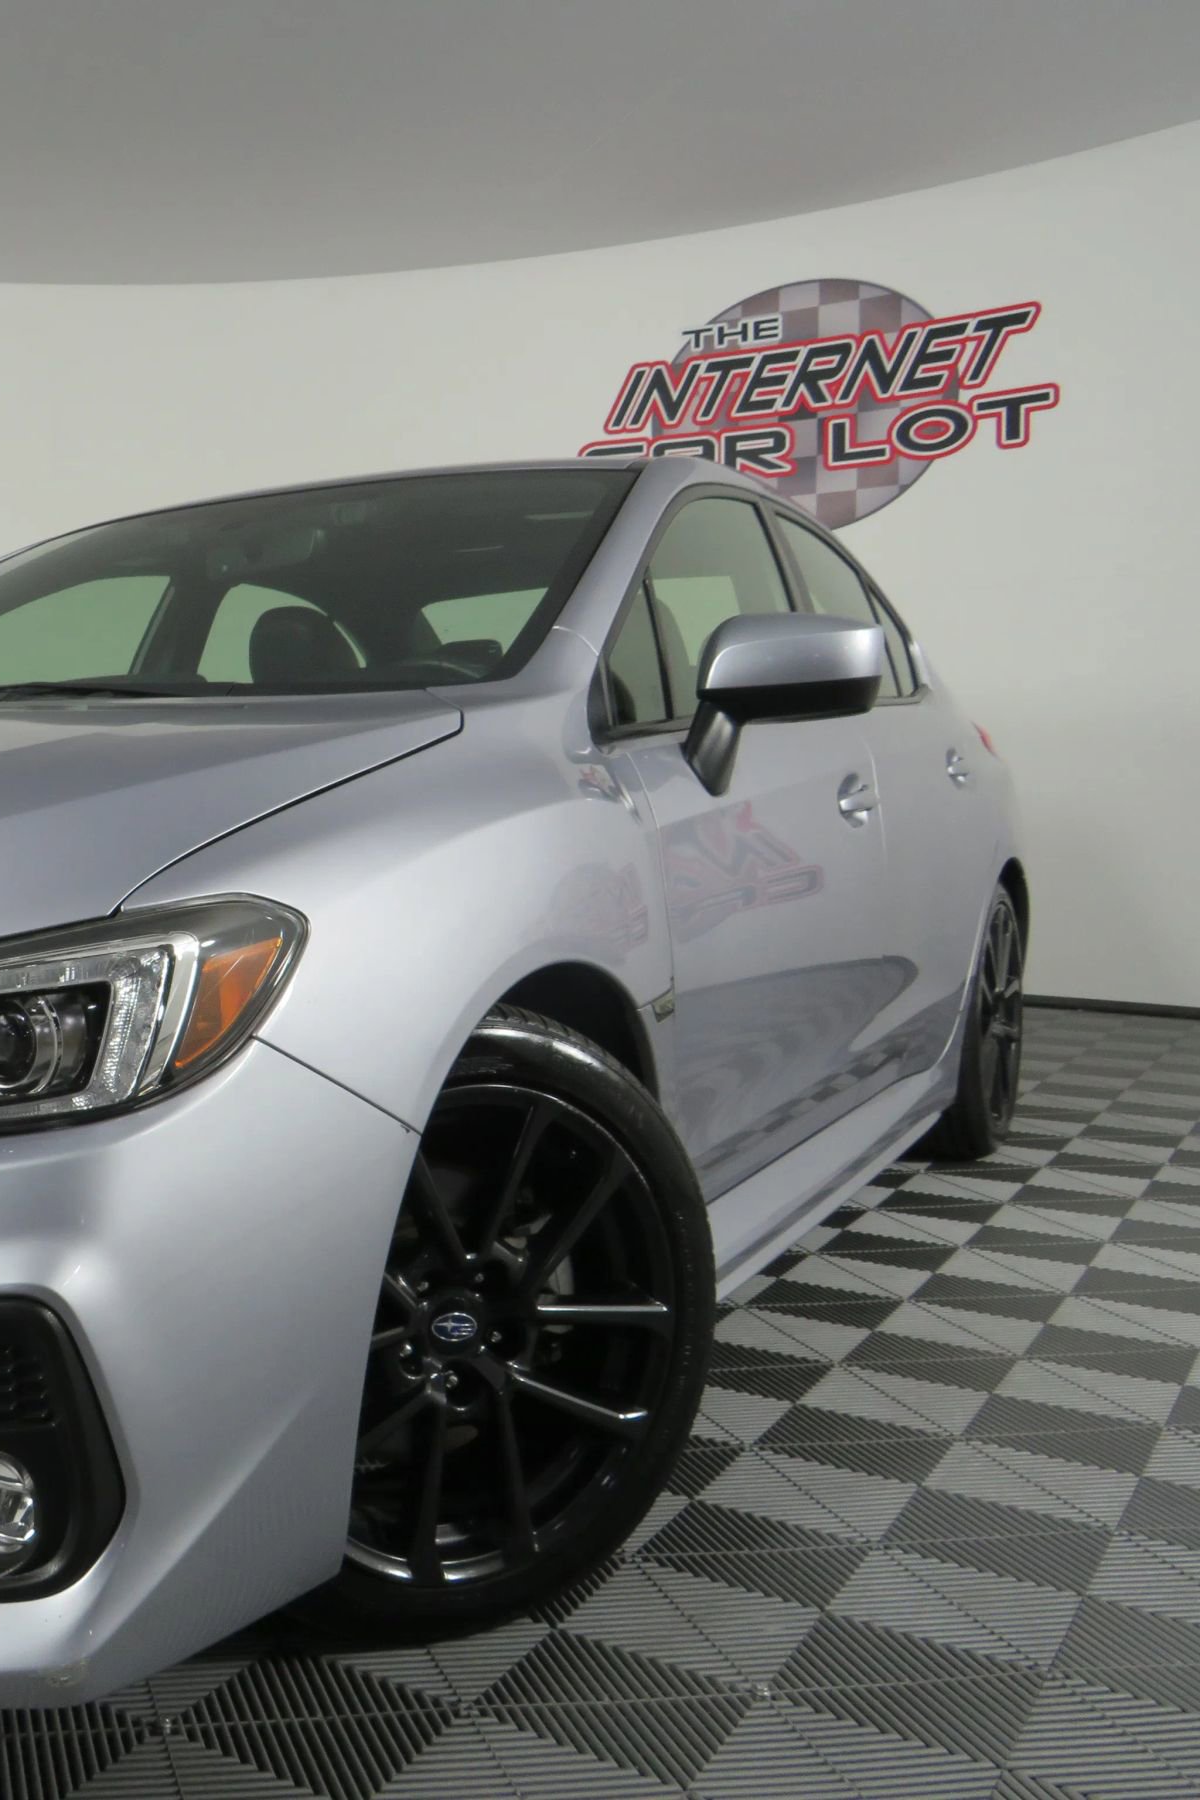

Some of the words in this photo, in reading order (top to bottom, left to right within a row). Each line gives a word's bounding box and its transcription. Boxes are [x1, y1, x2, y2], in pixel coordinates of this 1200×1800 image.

[604, 303, 1040, 433] INTERNET
[681, 313, 783, 351] THE
[579, 423, 796, 477] AR
[823, 384, 1058, 470] LOT
